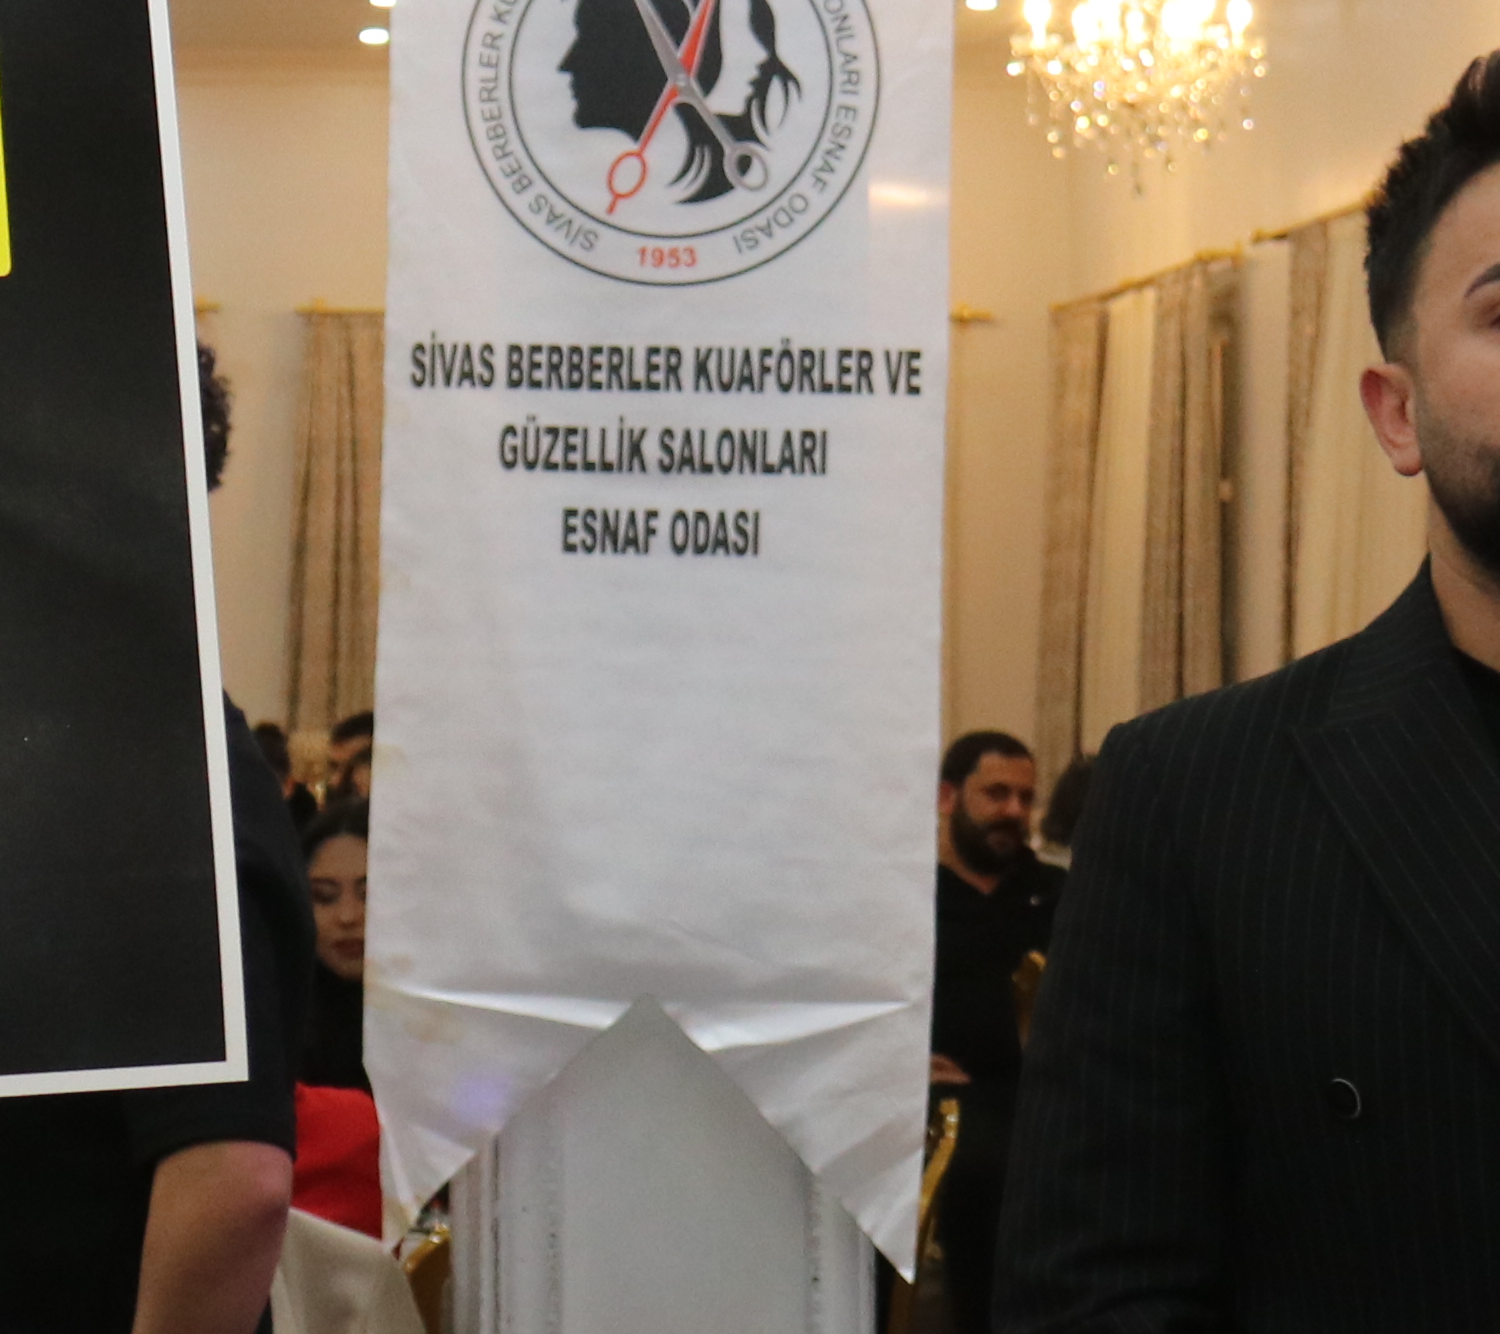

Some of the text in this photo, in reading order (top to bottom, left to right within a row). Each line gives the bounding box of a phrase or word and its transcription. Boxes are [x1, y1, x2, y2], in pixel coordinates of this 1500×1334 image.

[479, 31, 533, 194] BERBERLER
[811, 103, 858, 193] ESNAF
[733, 193, 809, 254] ODASI
[636, 245, 698, 269] 1953
[410, 331, 922, 396] SİVAS BERBERLER KUAFÖRLER VE
[499, 415, 828, 477] GÜZELLİK SALONLARI
[561, 507, 760, 558] ESNAF ODASI
